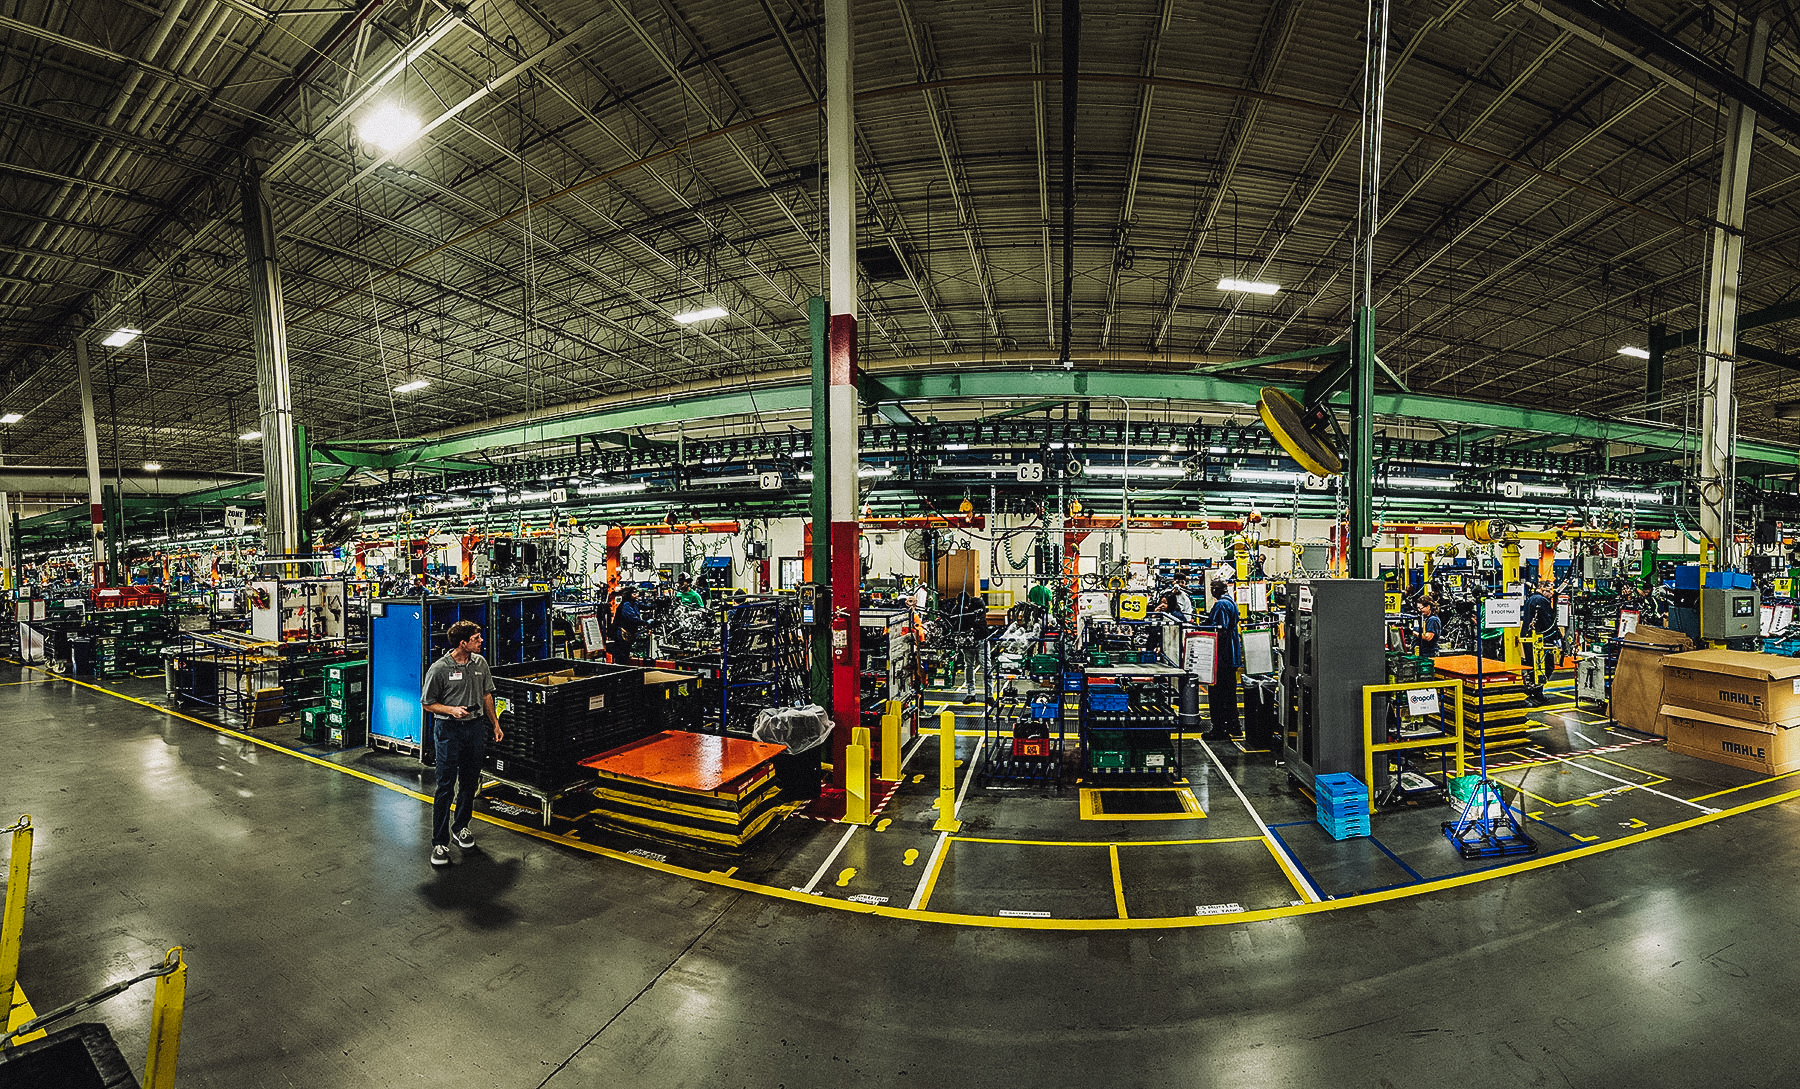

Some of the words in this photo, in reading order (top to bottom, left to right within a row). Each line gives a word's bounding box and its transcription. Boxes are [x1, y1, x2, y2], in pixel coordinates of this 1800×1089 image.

[228, 510, 243, 518] ZONE
[1719, 690, 1762, 706] MAHLE
[1722, 741, 1765, 758] MAHLE
